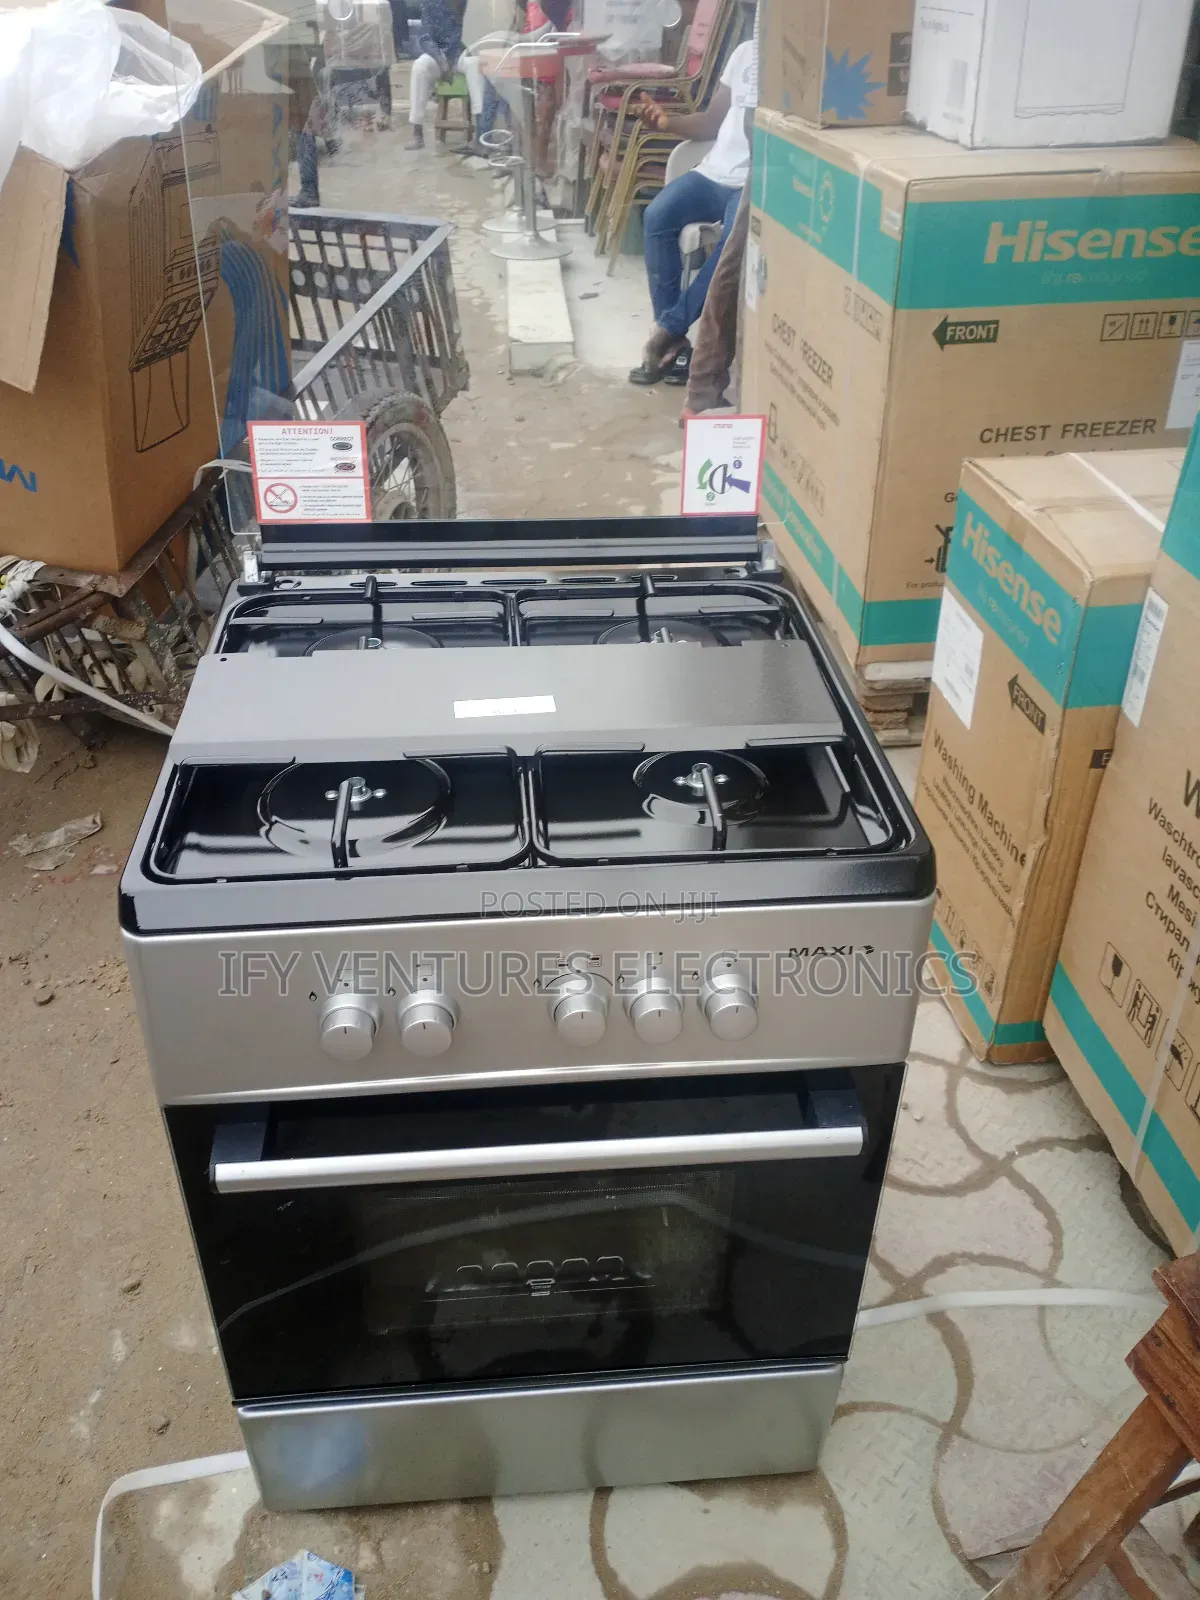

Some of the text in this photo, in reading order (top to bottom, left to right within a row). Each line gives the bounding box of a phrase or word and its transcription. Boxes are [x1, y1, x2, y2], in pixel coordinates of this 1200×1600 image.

[983, 220, 1200, 264] Hisense
[946, 324, 997, 340] FRONT
[979, 418, 1157, 444] CHEST FREEZER
[962, 511, 1061, 647] Hisense
[1013, 683, 1045, 728] FRONT
[934, 728, 976, 805] Washing
[788, 945, 855, 958] MAXI
